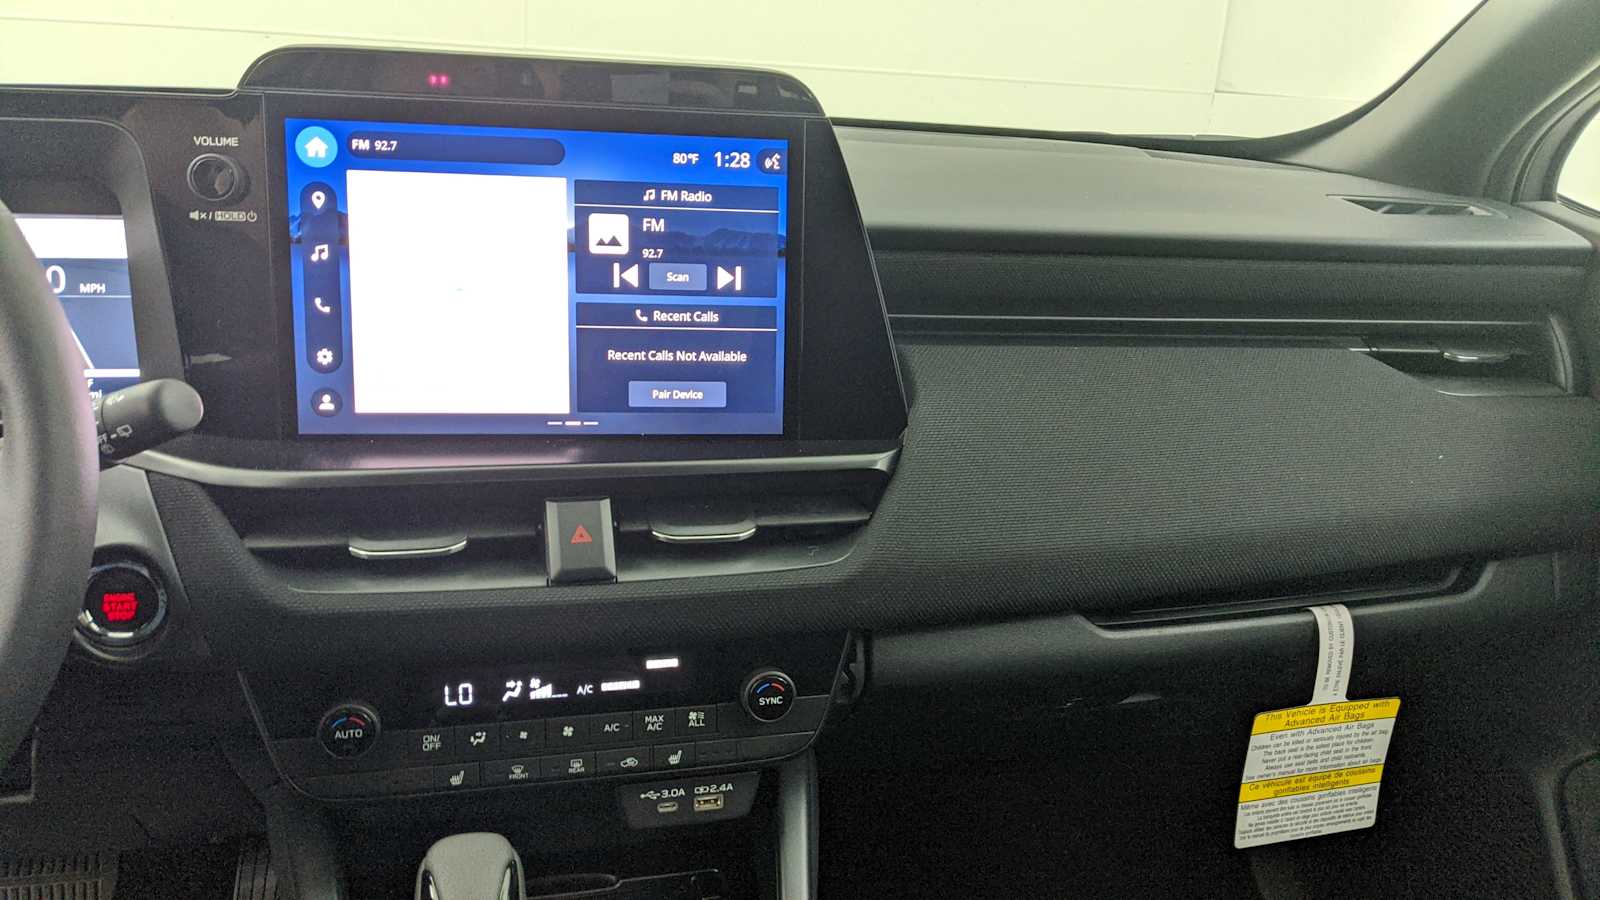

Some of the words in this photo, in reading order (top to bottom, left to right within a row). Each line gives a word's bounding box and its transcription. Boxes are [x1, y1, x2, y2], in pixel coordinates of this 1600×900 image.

[194, 136, 239, 147] VOLUME
[352, 139, 370, 152] FM
[374, 138, 398, 152] 92.7
[714, 152, 750, 169] 1:28
[661, 190, 678, 202] FM
[680, 191, 712, 202] Radio
[215, 211, 246, 221] HOLD
[642, 218, 664, 232] FM
[642, 249, 664, 258] 92.7
[666, 272, 690, 282] Scan
[80, 283, 106, 294] MPH
[653, 310, 691, 322] Recent
[694, 311, 720, 323] Calls
[608, 350, 646, 361] Recent
[648, 350, 674, 362] Calls
[676, 351, 696, 362] Not
[698, 351, 748, 362] Available
[652, 390, 670, 400] Pair
[672, 390, 704, 400] Device
[444, 682, 473, 706] LO
[576, 684, 594, 695] A/C
[758, 696, 784, 706] SYNC
[1286, 708, 1316, 718] Vehicle
[1330, 702, 1370, 712] Equipped
[644, 714, 664, 724] MAX
[688, 718, 705, 727] ALL
[1285, 716, 1326, 726] Advanced
[1344, 712, 1365, 720] Bags
[604, 722, 620, 732] A/C
[646, 722, 662, 732] A/C
[1306, 726, 1342, 735] Advanced
[1356, 722, 1374, 730] Bags
[334, 728, 363, 740] AUTO
[422, 734, 440, 743] ON/
[422, 742, 442, 752] OFF
[508, 772, 529, 780] FRONT
[662, 788, 686, 798] 3.0A
[710, 782, 734, 793] 2.4A
